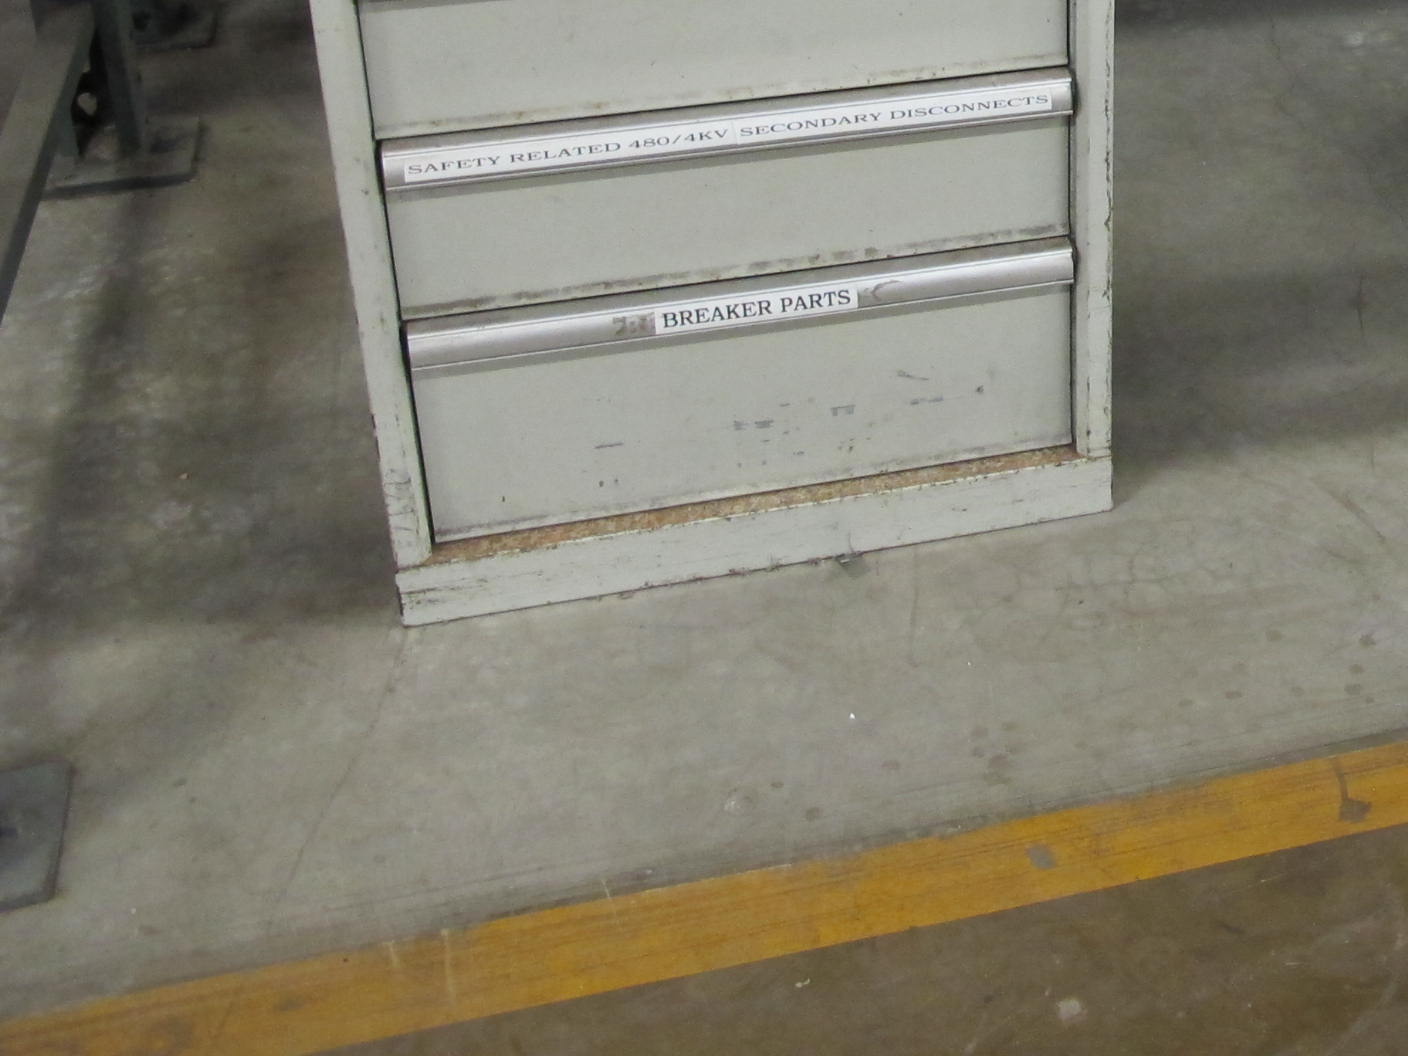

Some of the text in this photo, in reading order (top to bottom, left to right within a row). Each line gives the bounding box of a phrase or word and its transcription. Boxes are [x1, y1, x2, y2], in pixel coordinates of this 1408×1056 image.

[407, 94, 1049, 175] SAFETY RELATED 480/4KV SECONDARY DISCONNECTS
[662, 289, 851, 329] BREAKER PARTS
